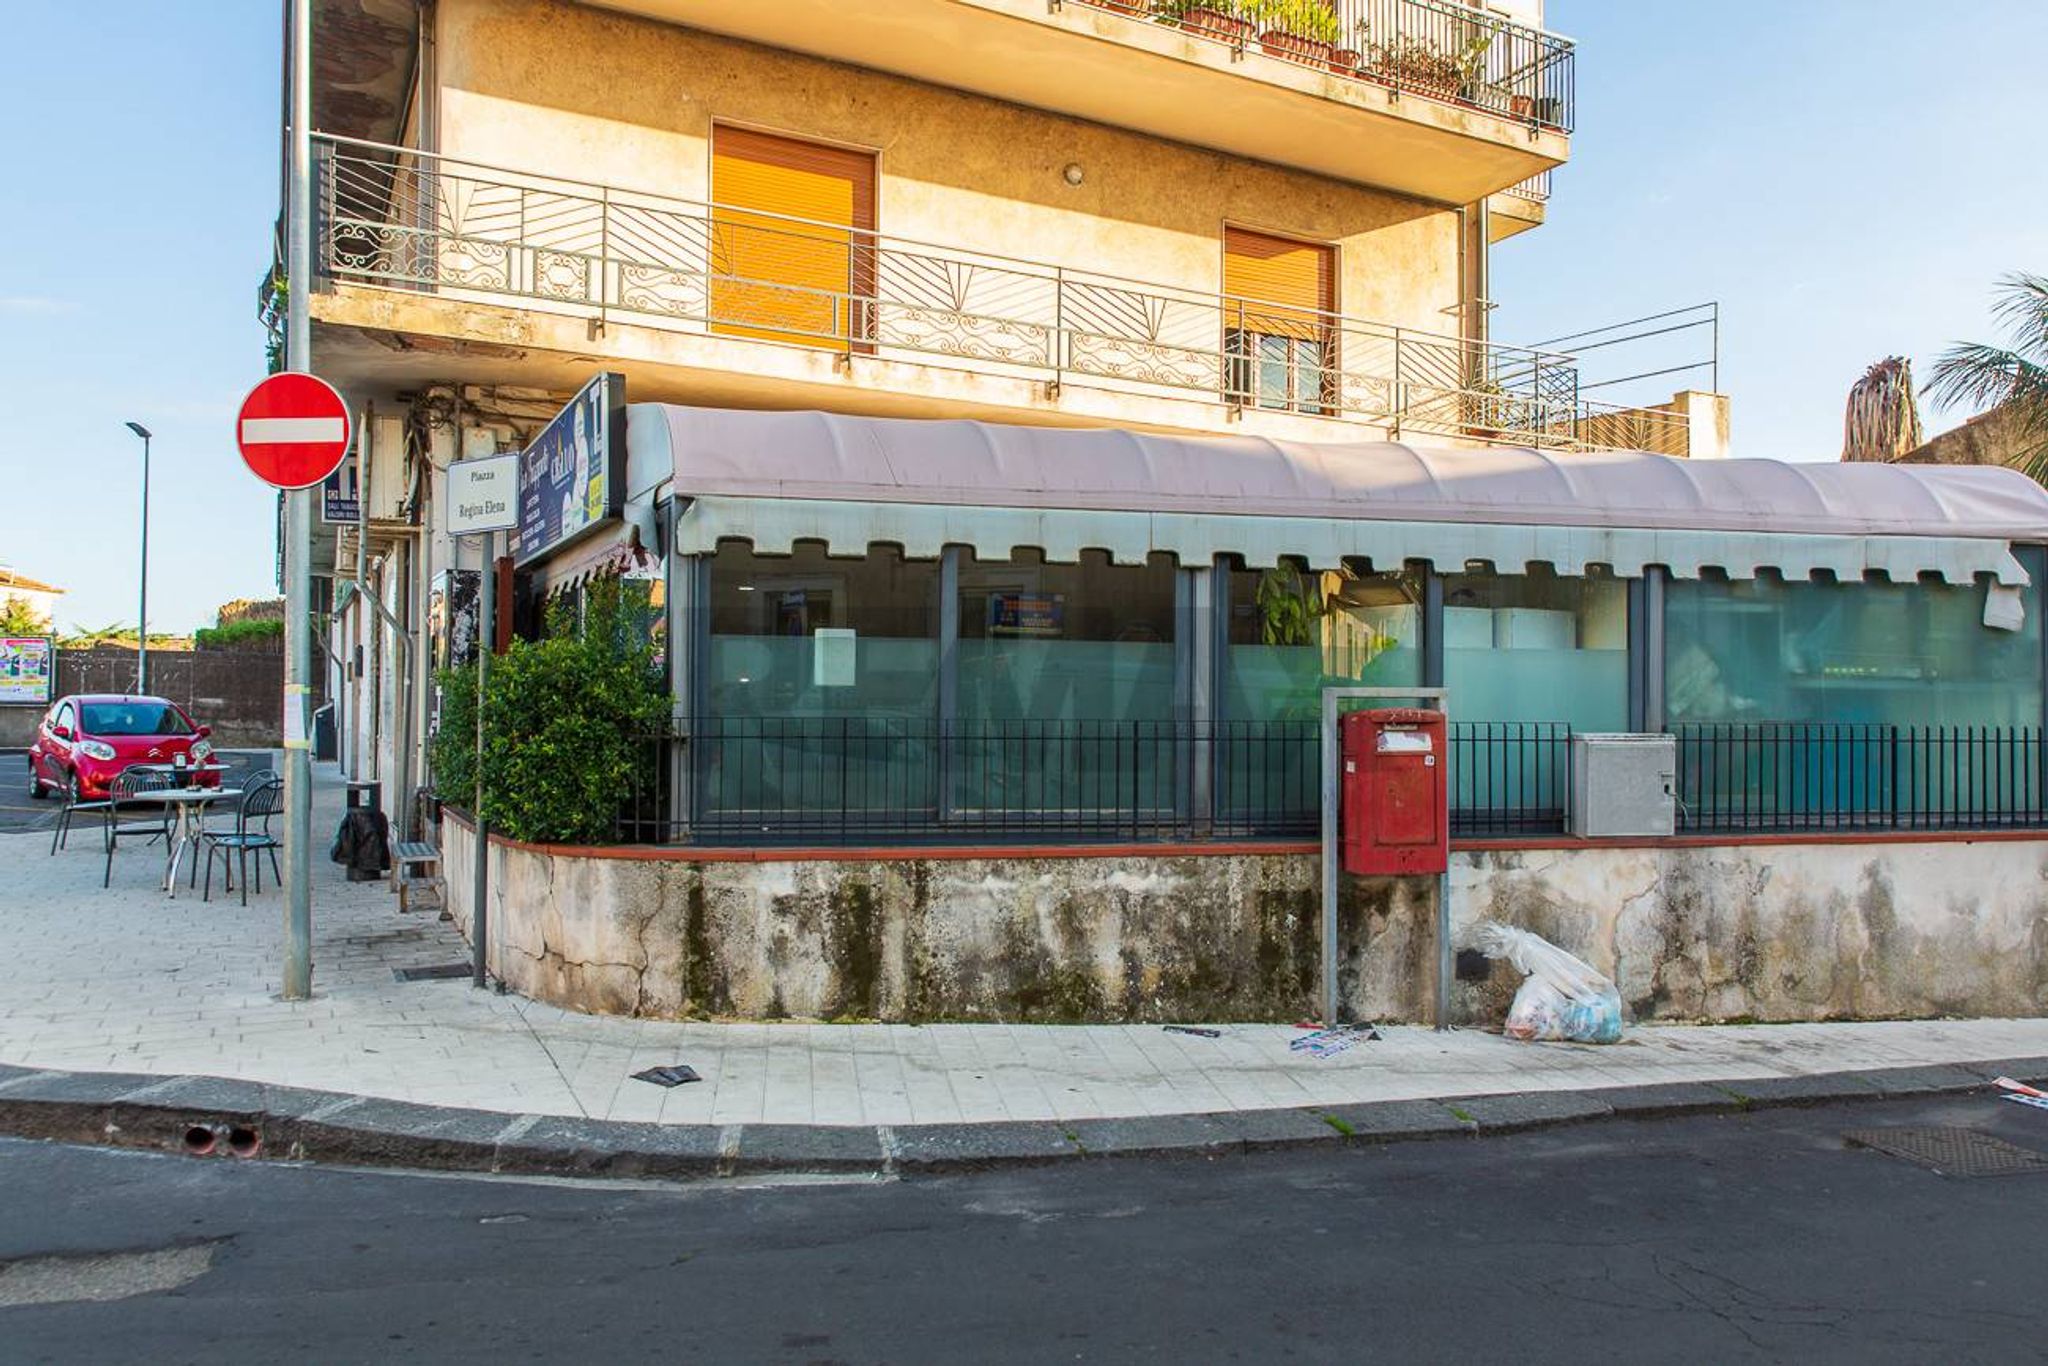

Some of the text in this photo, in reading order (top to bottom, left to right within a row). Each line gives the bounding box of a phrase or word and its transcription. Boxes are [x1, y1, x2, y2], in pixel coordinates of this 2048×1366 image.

[470, 470, 495, 482] Piazza
[458, 500, 506, 520] Regina Elena
